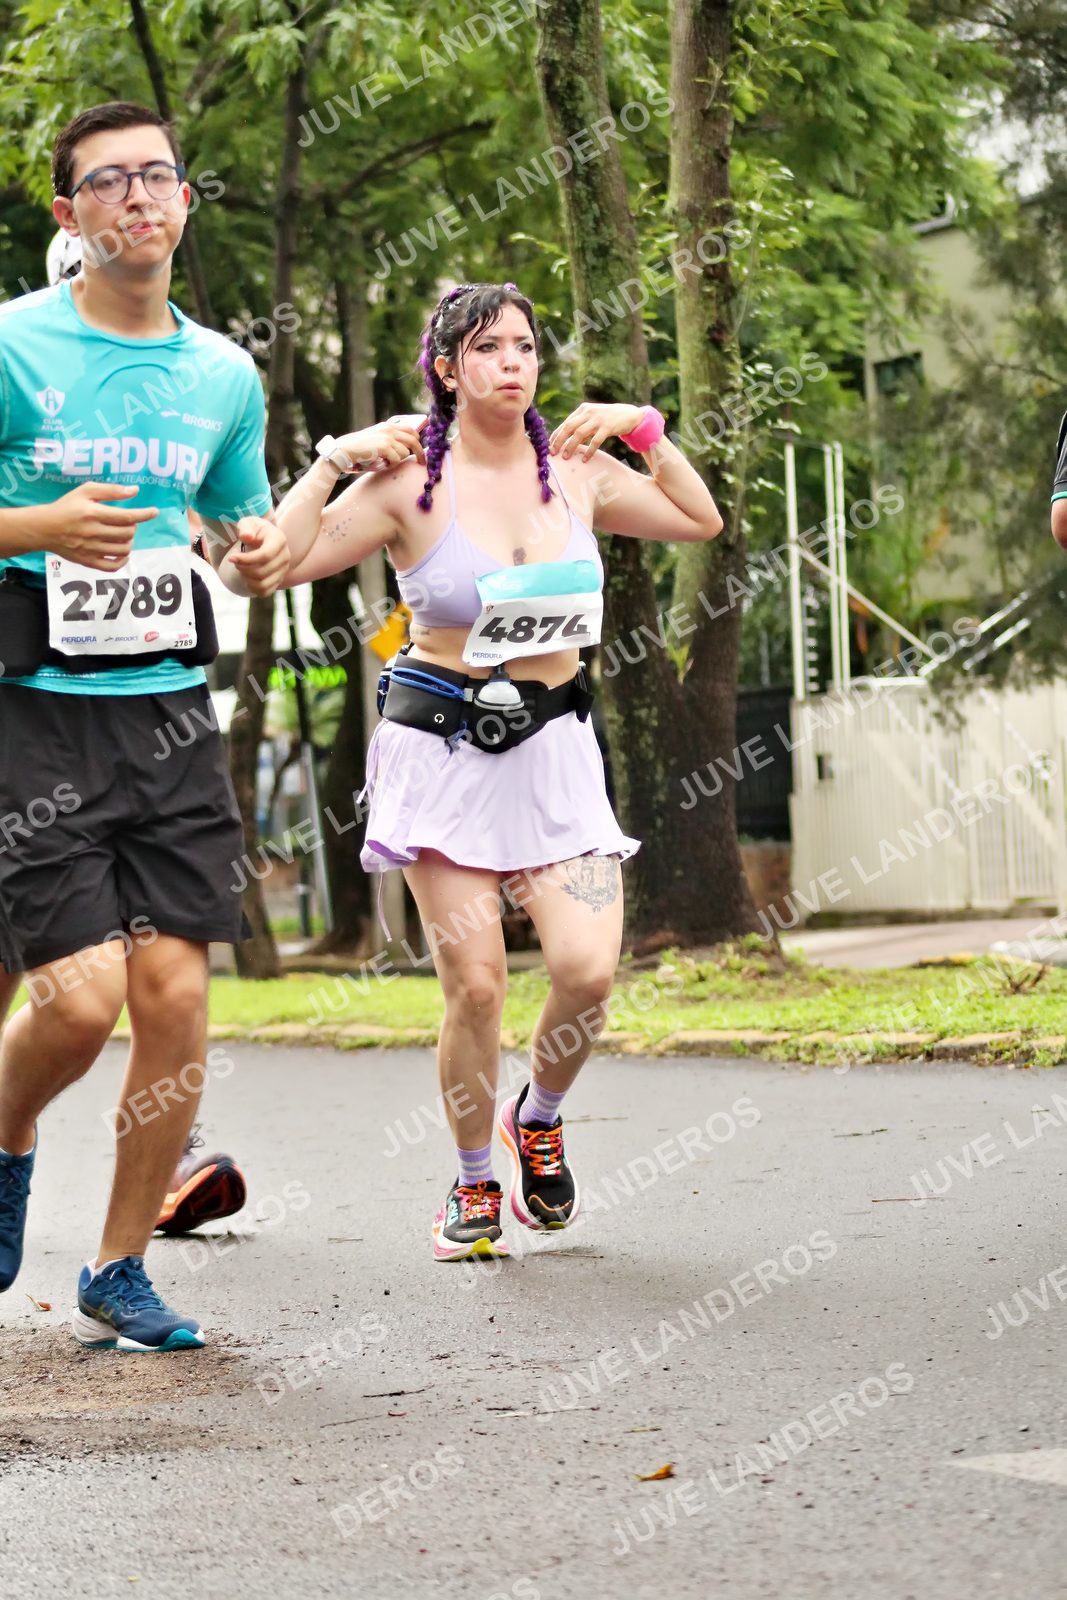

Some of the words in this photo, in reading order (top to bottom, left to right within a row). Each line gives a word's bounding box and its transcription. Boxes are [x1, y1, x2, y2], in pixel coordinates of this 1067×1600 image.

[182, 413, 223, 432] BROOKS
[60, 573, 182, 622] 2789
[61, 636, 97, 644] PERDURA
[174, 640, 193, 648] 2789
